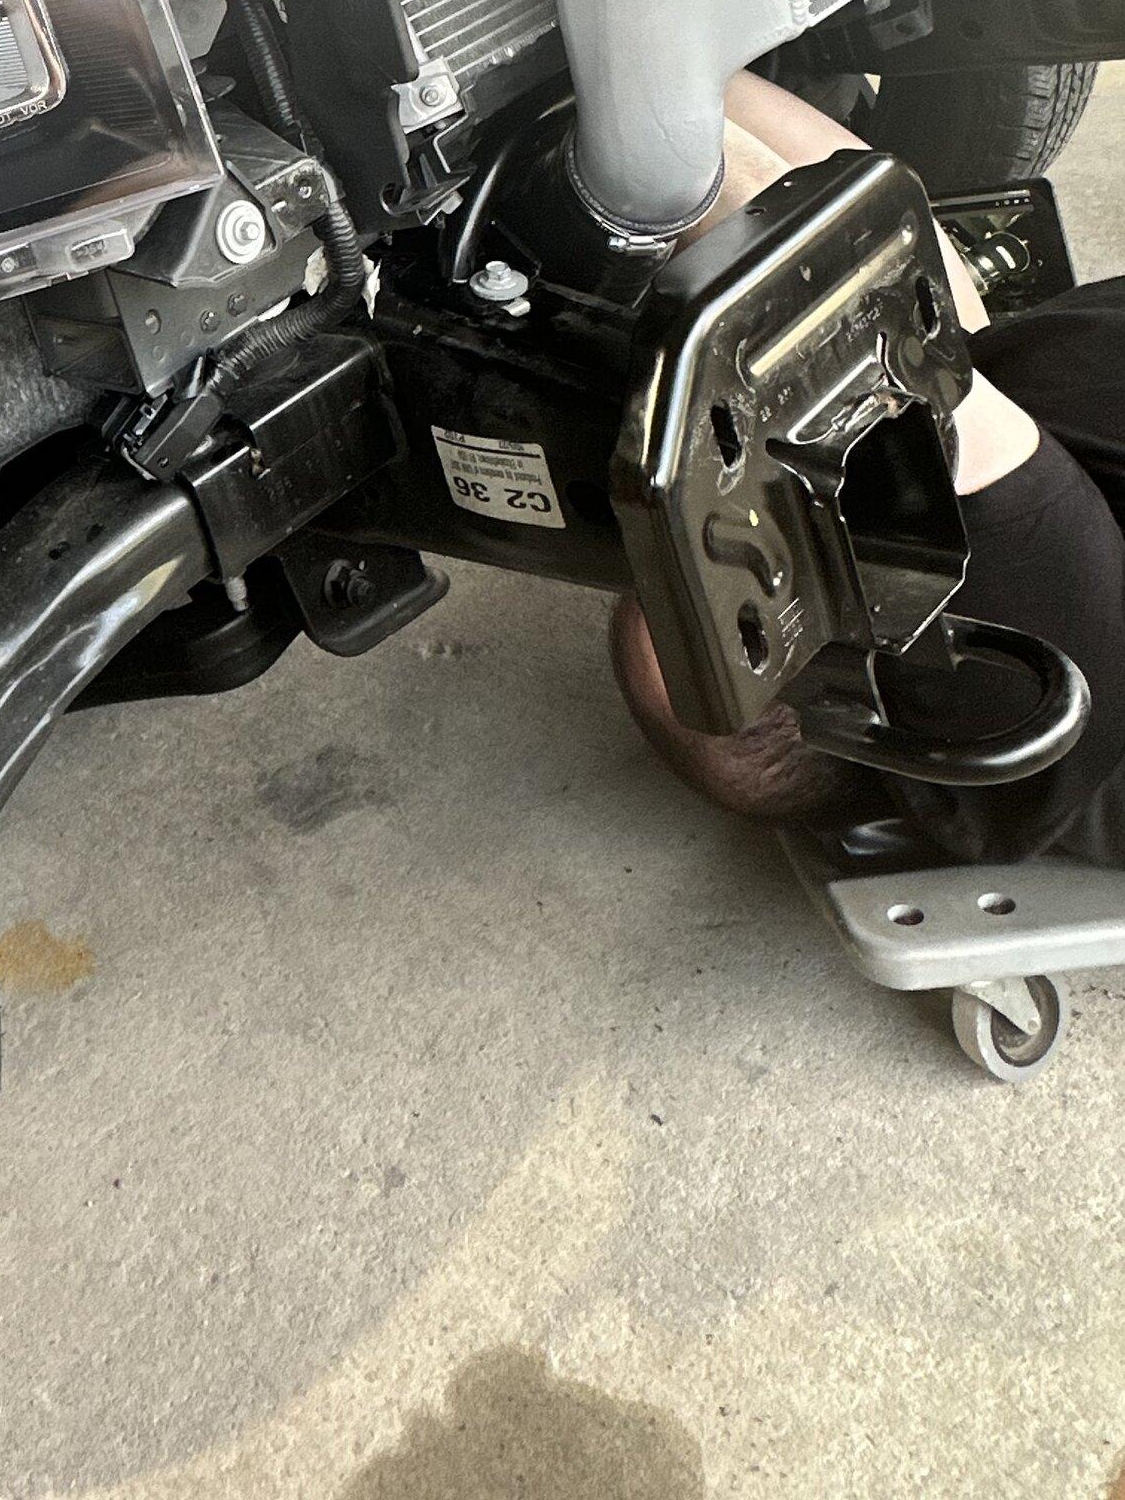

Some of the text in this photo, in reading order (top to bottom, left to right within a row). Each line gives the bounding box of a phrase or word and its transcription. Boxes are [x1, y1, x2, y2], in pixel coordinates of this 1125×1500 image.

[19, 100, 49, 119] VOR
[452, 476, 552, 513] C2 36
